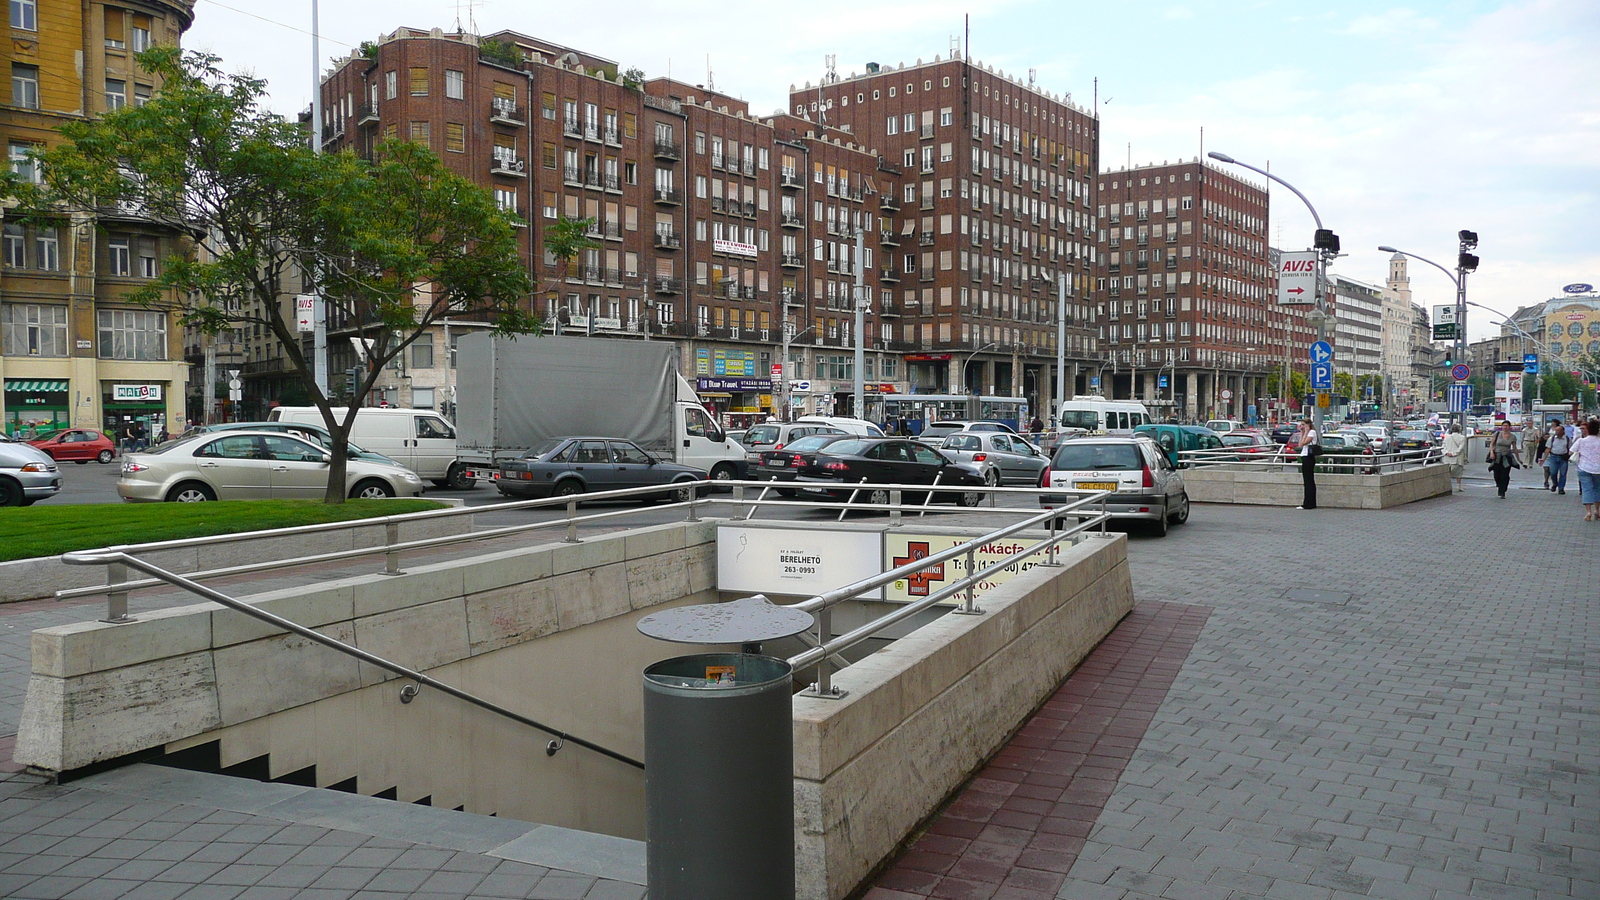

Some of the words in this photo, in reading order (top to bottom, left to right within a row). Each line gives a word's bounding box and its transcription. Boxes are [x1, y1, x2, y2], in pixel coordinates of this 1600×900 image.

[1282, 260, 1315, 272] AVIS
[298, 300, 313, 309] AVIS
[1316, 367, 1327, 383] P
[708, 380, 721, 388] Blue
[721, 380, 738, 389] Travel
[118, 386, 157, 399] MATCH
[953, 559, 962, 570] T:
